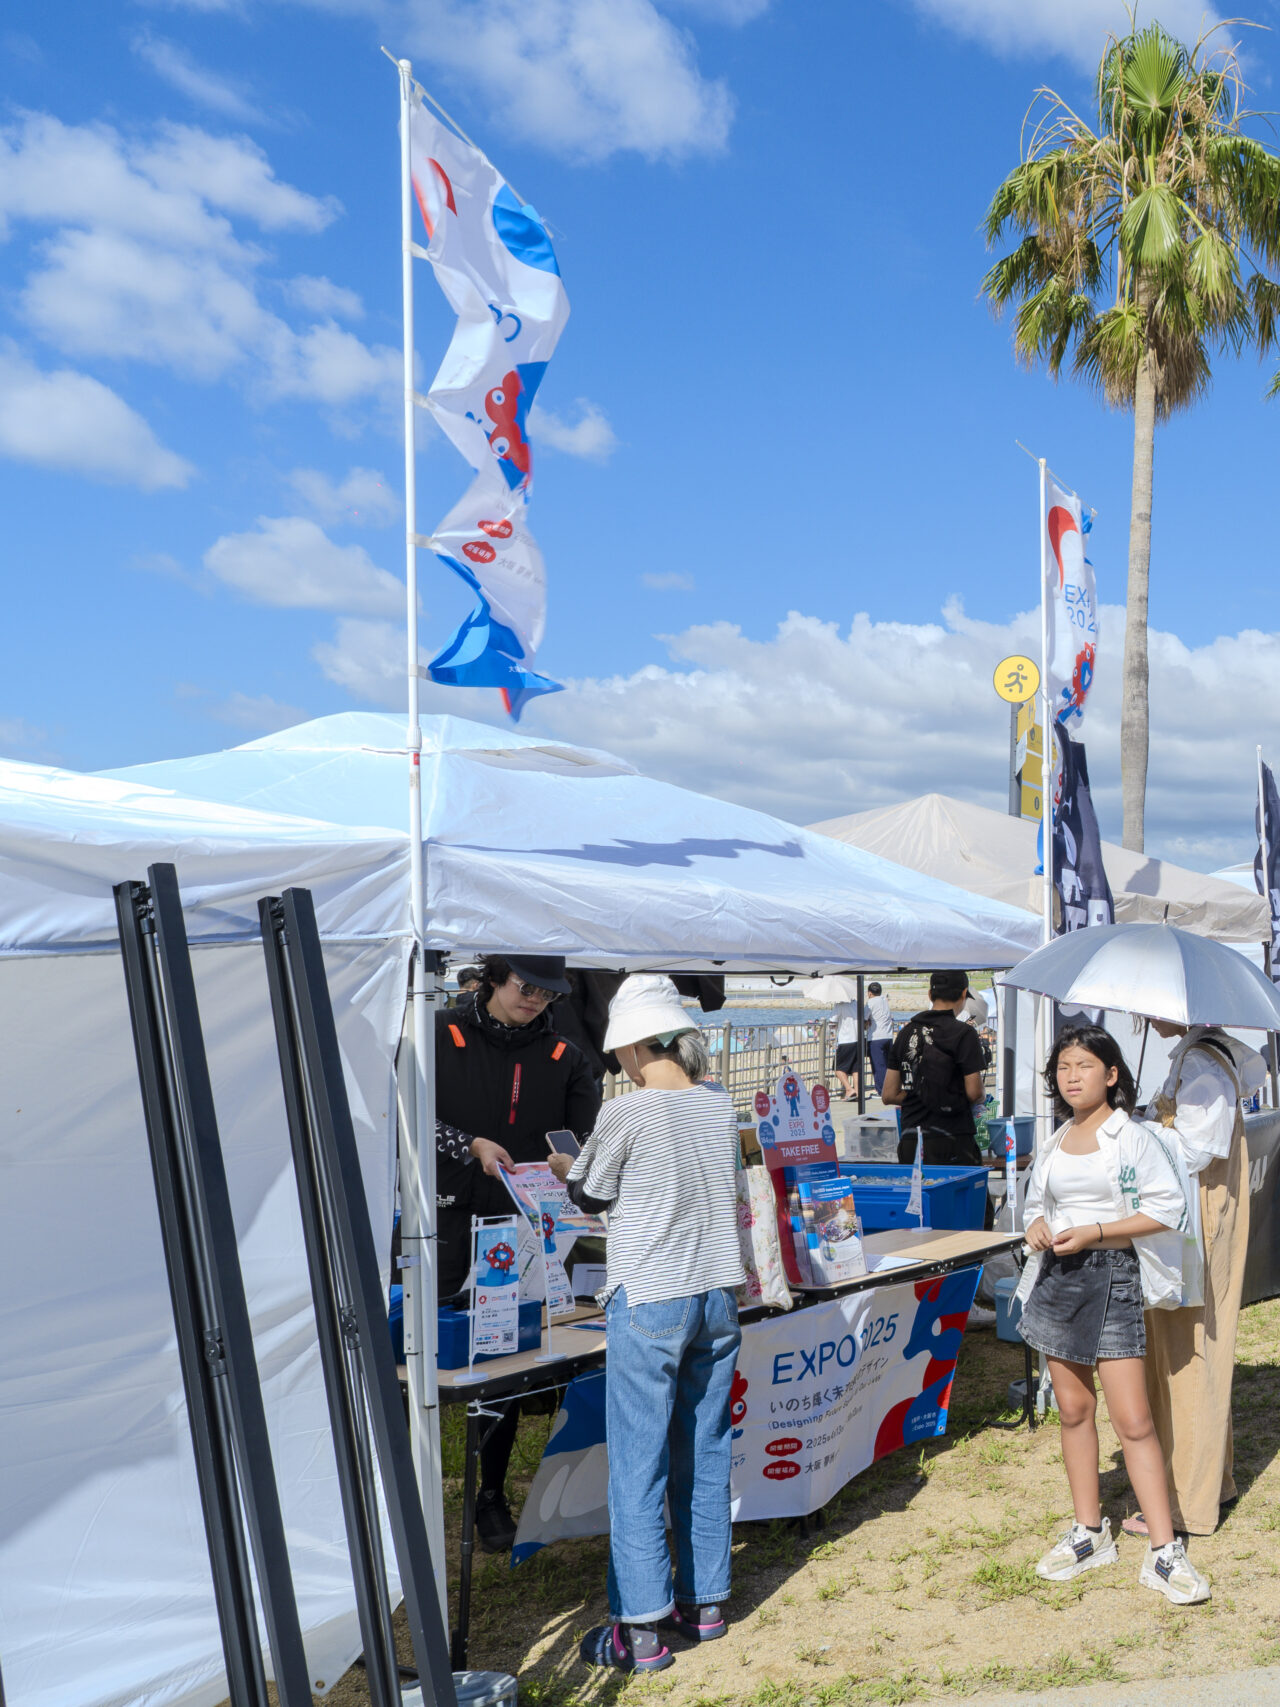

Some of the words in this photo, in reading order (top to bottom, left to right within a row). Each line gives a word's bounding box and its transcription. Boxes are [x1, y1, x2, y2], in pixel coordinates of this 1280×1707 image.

[788, 1121, 805, 1129] EXPO
[790, 1129, 806, 1137] 2025
[781, 1146, 801, 1158] TAKE
[801, 1144, 820, 1154] FREE
[771, 1333, 856, 1386] EXPO
